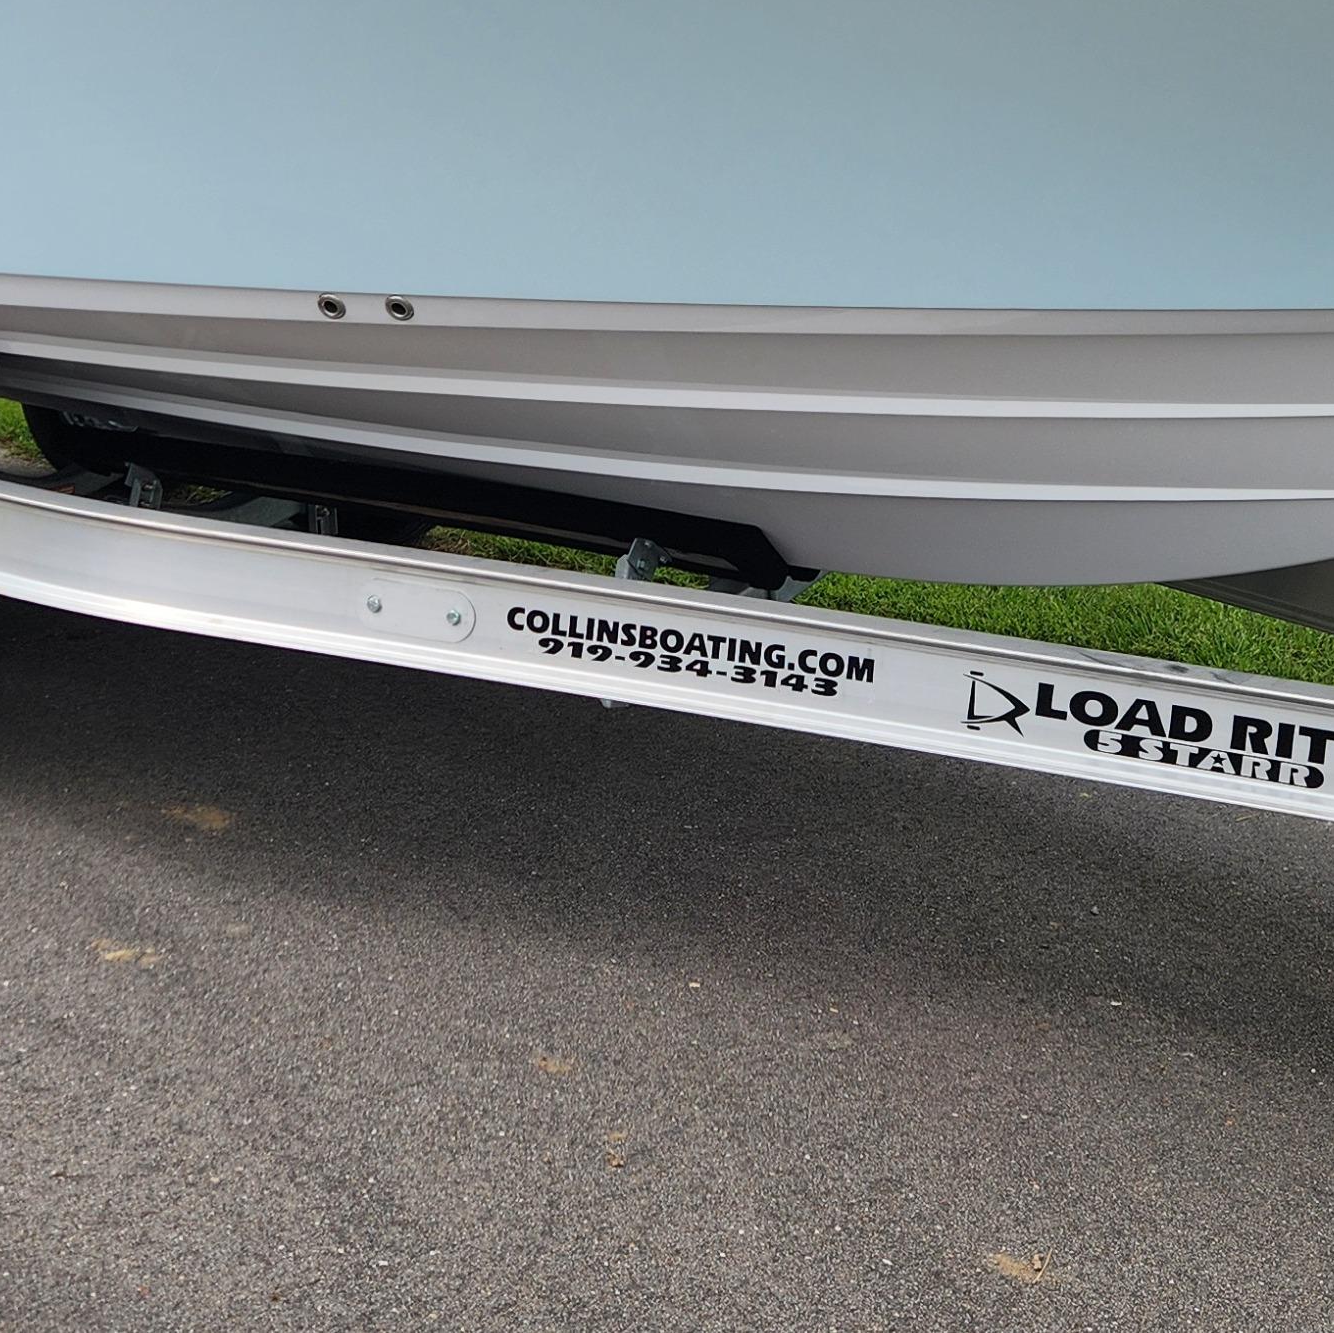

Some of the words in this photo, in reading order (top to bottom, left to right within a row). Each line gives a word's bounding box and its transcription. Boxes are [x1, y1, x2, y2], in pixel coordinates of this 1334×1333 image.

[506, 606, 876, 683] COLLINSBOATING.COM
[537, 637, 839, 697] 919-934-3143
[1034, 682, 1213, 743] LOAD
[1097, 732, 1123, 754] 5
[1138, 740, 1310, 788] STARR
